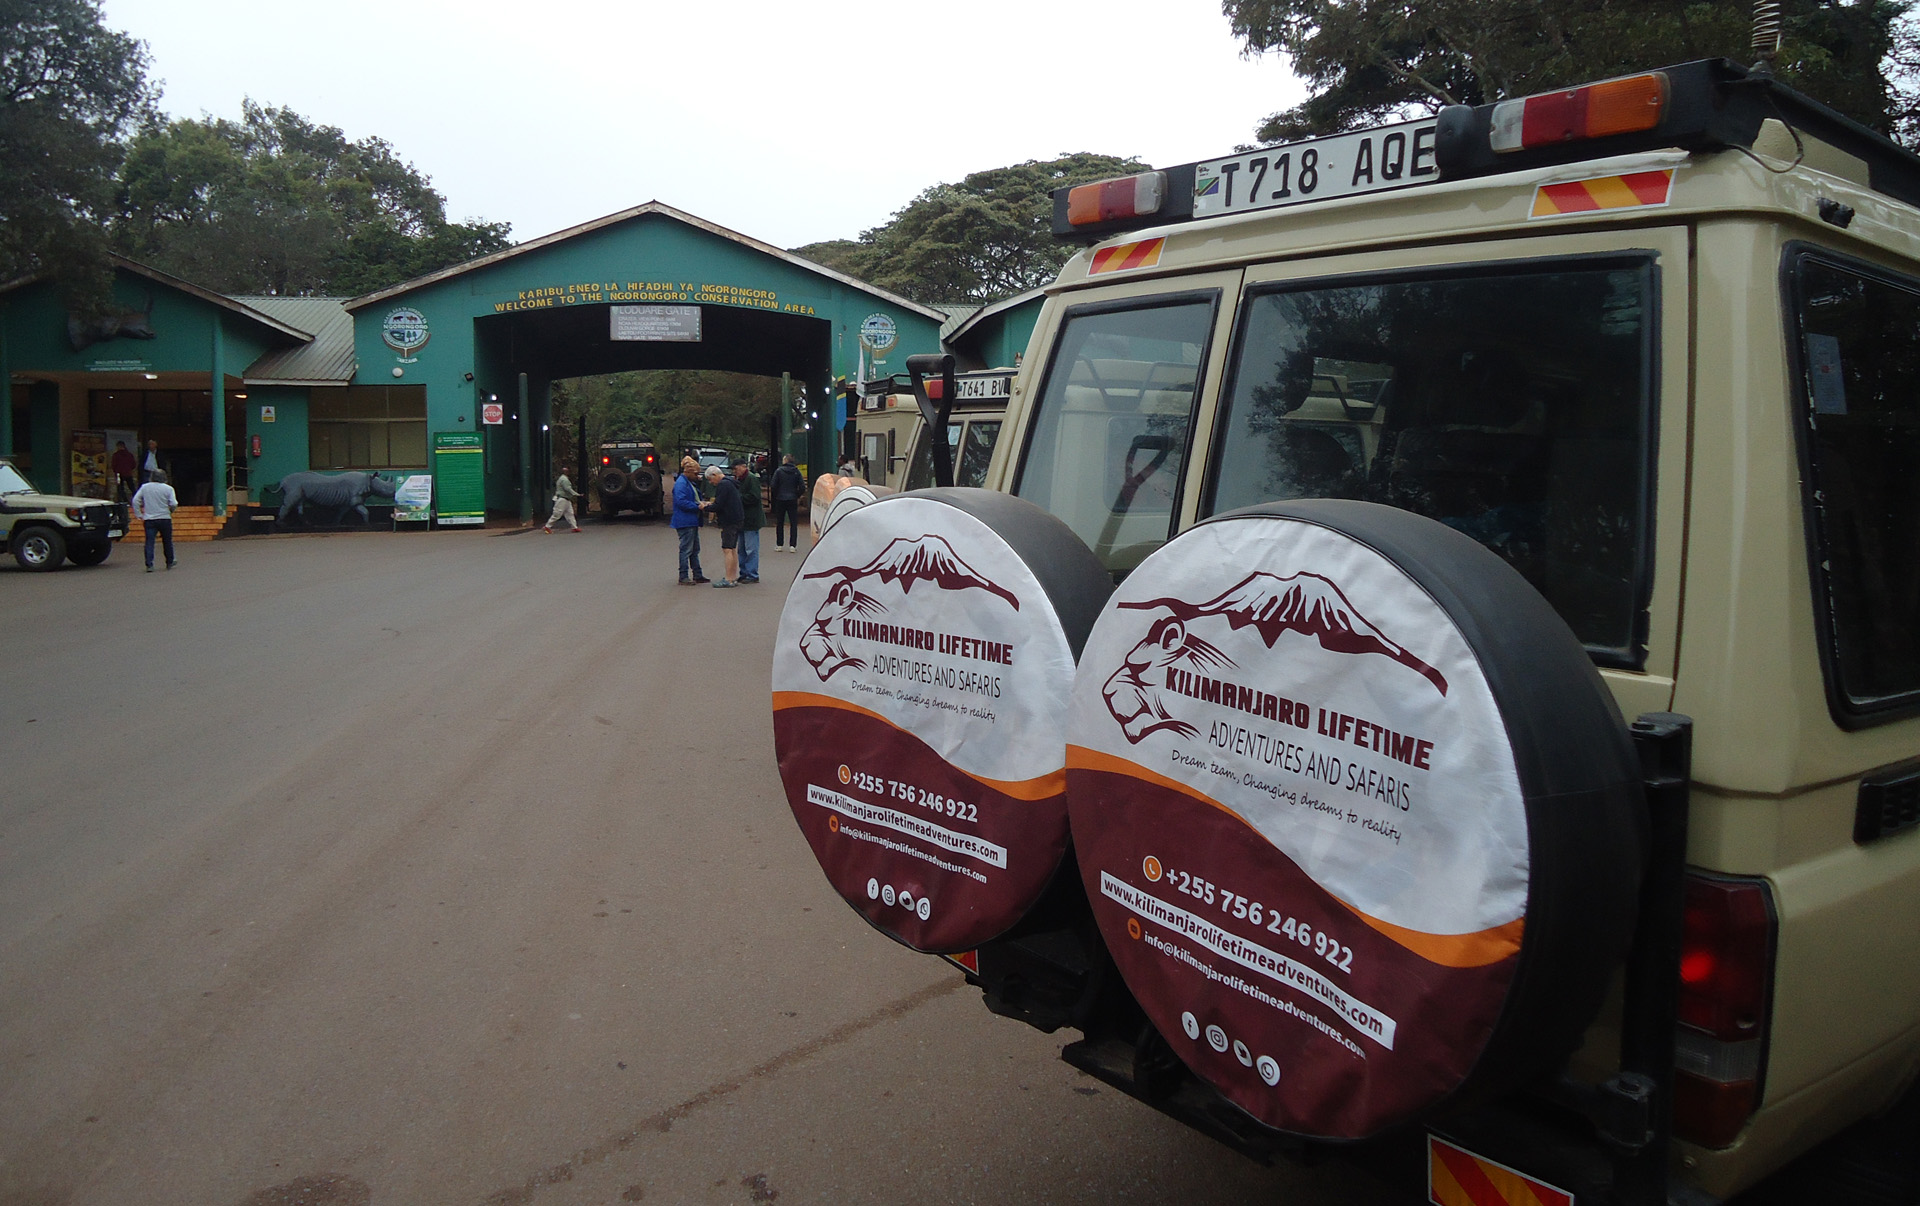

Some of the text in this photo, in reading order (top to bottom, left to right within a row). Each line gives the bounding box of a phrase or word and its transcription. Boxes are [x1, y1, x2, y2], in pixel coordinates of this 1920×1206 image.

[1221, 125, 1436, 207] T718 AQE
[494, 292, 815, 315] WELCOME TO THE NGORONGORO CONSERVATION AREA
[518, 282, 776, 300] KARIBU ENEO LA HIFADHI YA NGORONGORO
[620, 306, 691, 316] LODUARE GATE
[962, 379, 1007, 397] T641 BV
[843, 618, 1013, 665] KILIMANJARO LIFETIME
[851, 680, 996, 724] Dream team, Changing dreams to reality
[872, 654, 1001, 698] ADVENTURES AND SAFARIS
[1165, 666, 1435, 771] KILIMANJARO LIFETIME
[1208, 719, 1411, 812] ADVENTURES AND SAFARIS
[810, 788, 999, 862] www.kilimanjarolifetimeadventures.com
[852, 770, 978, 823] +255 756 246 922
[1171, 749, 1402, 846] Dream team, Changing dreams to reality
[839, 823, 987, 884] info@kilimanjarolifetimeadventures.com
[1166, 868, 1354, 974] +255 756 246 922
[1104, 879, 1384, 1036] www.kilimanjarolifetimeadventures.com
[1144, 931, 1367, 1060] info@kilimanjarolifetimeadventures.com
